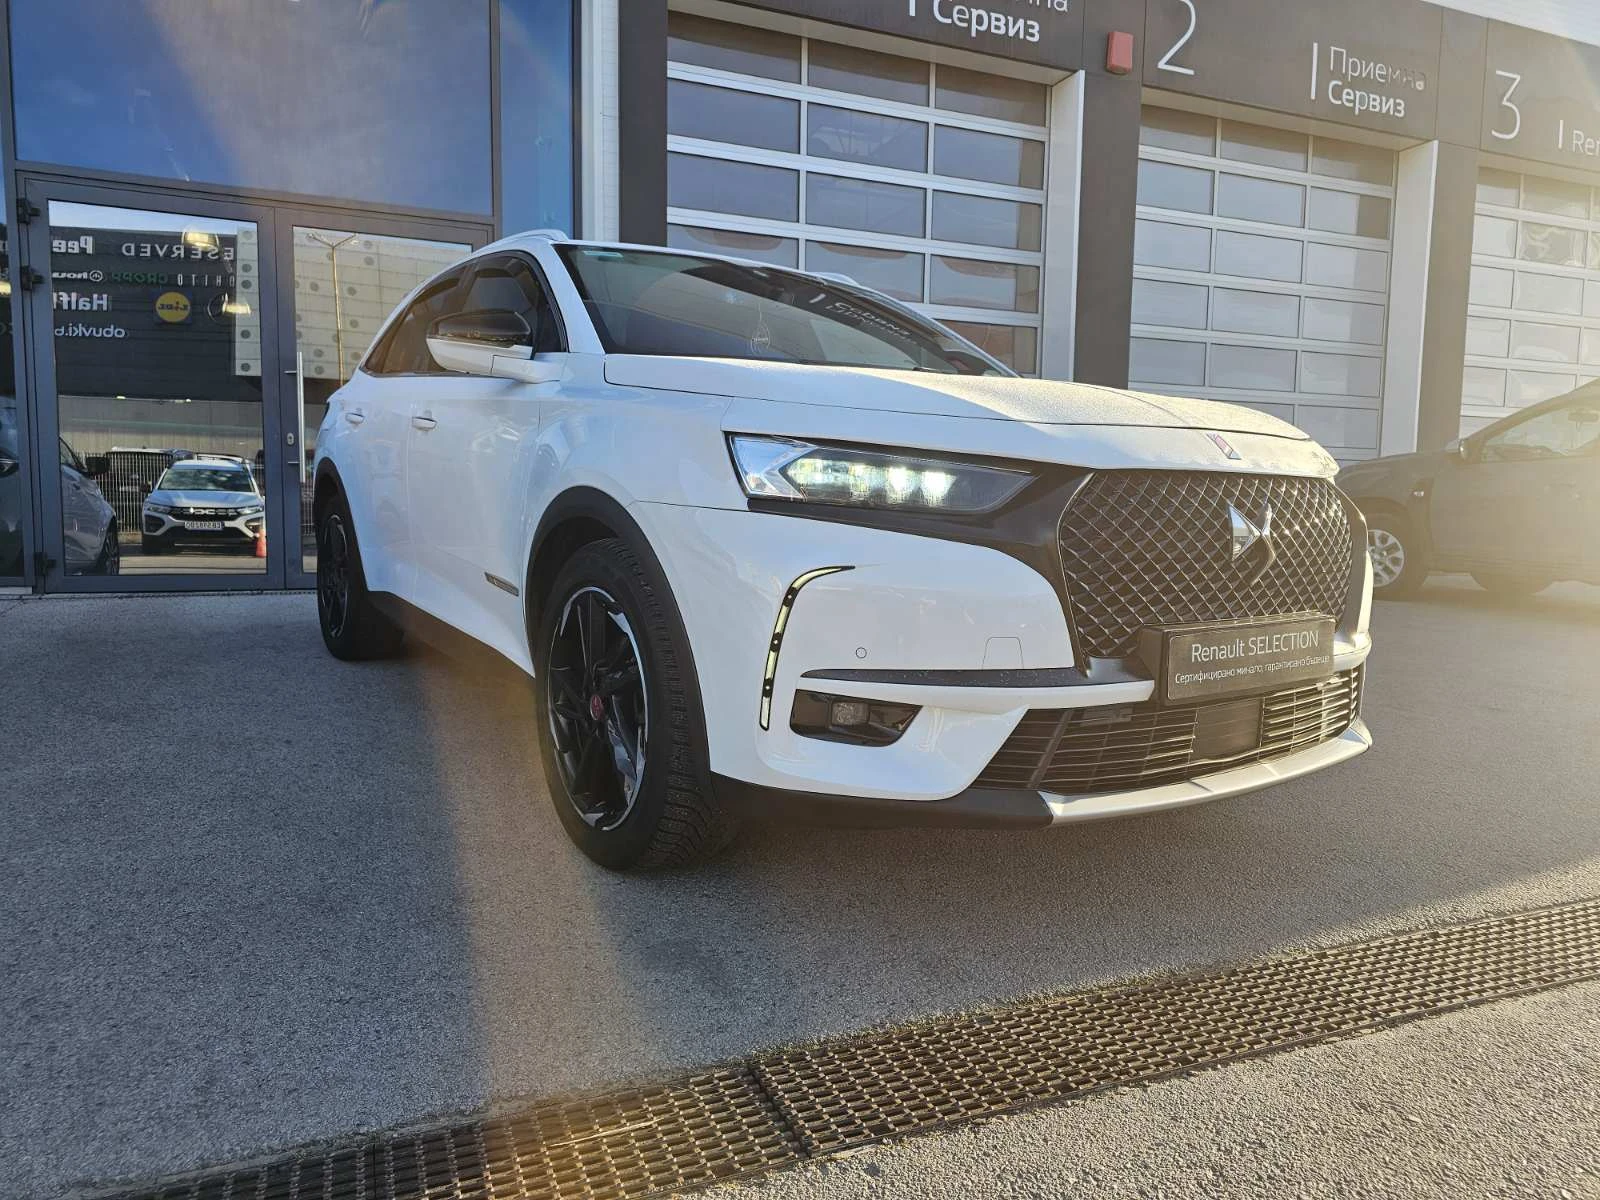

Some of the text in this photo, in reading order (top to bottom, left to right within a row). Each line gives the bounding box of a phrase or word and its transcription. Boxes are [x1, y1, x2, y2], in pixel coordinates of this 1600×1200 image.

[933, 0, 1040, 43] Сервиз
[1157, 0, 1196, 75] 2
[1328, 80, 1405, 118] Сервиз
[1491, 69, 1521, 140] 3
[1191, 631, 1319, 662] Renault SELECTION
[1175, 668, 1235, 685] Сертифицирано
